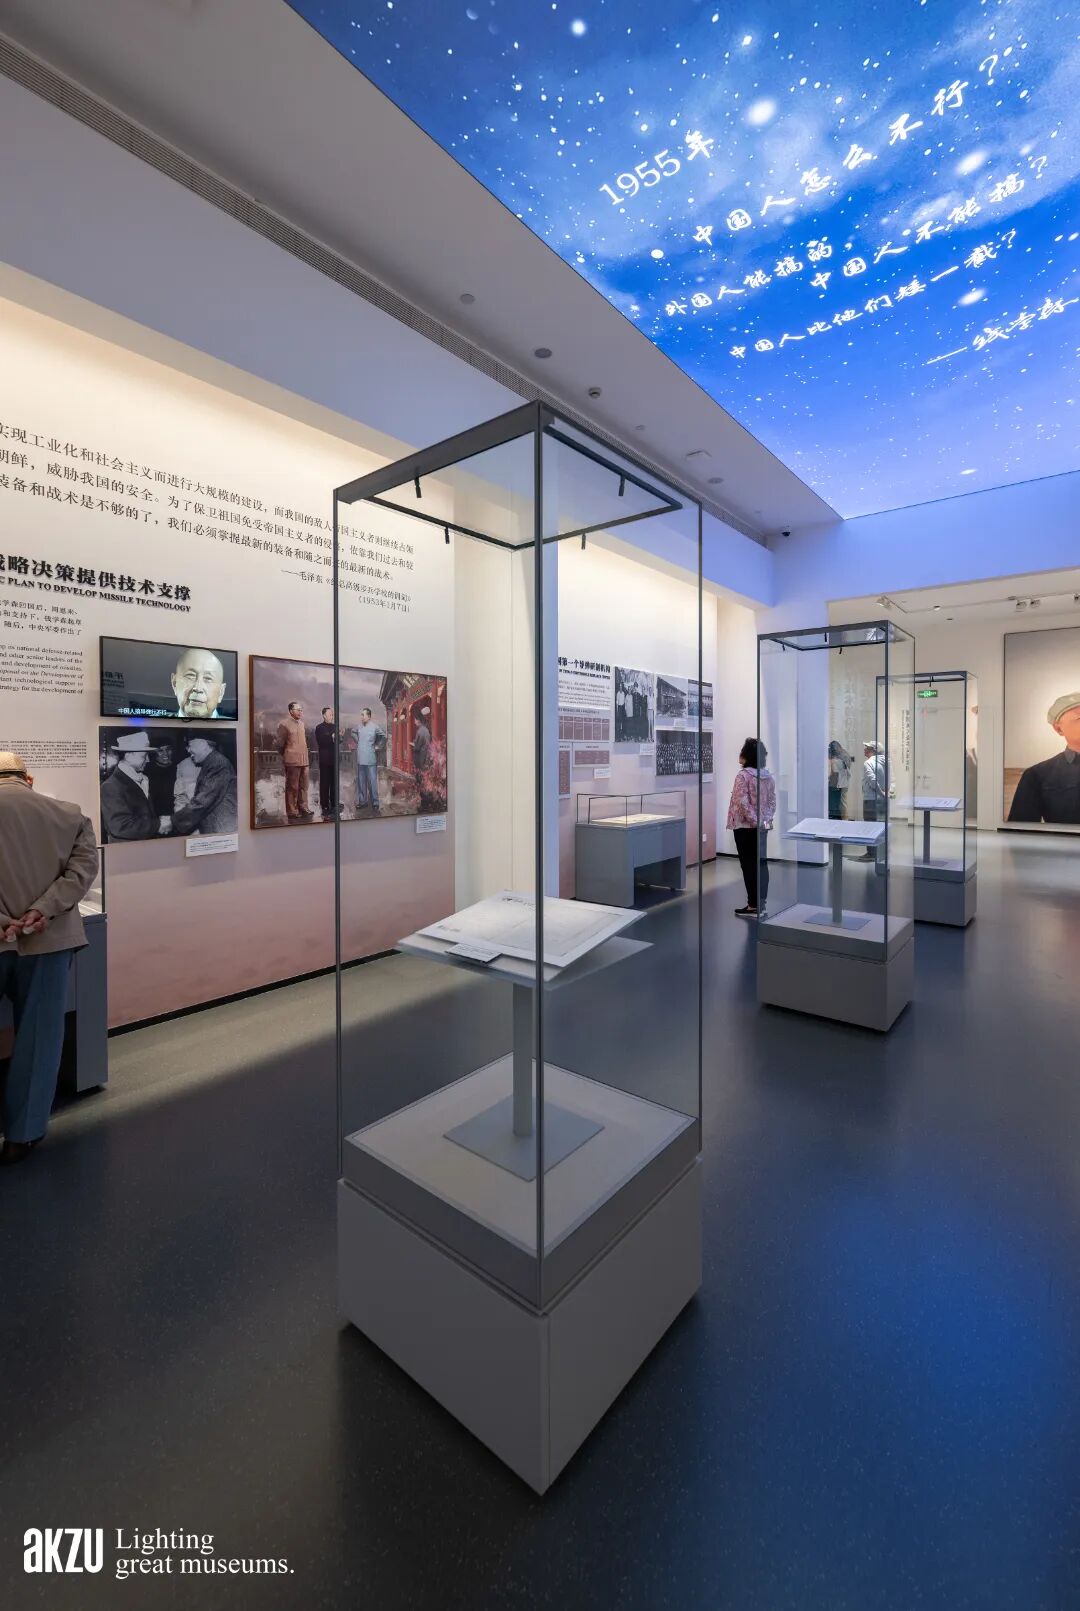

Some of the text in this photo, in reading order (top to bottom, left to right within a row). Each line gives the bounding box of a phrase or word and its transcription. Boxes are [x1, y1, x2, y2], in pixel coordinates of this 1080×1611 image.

[599, 129, 715, 206] 1955年
[0, 554, 191, 601] 略决策提供技术支撑
[8, 577, 35, 588] PLAN
[37, 581, 52, 591] TO
[53, 584, 98, 598] DEVELOP
[99, 591, 134, 604] MISSILE
[136, 597, 191, 612] TECHNOLOGY
